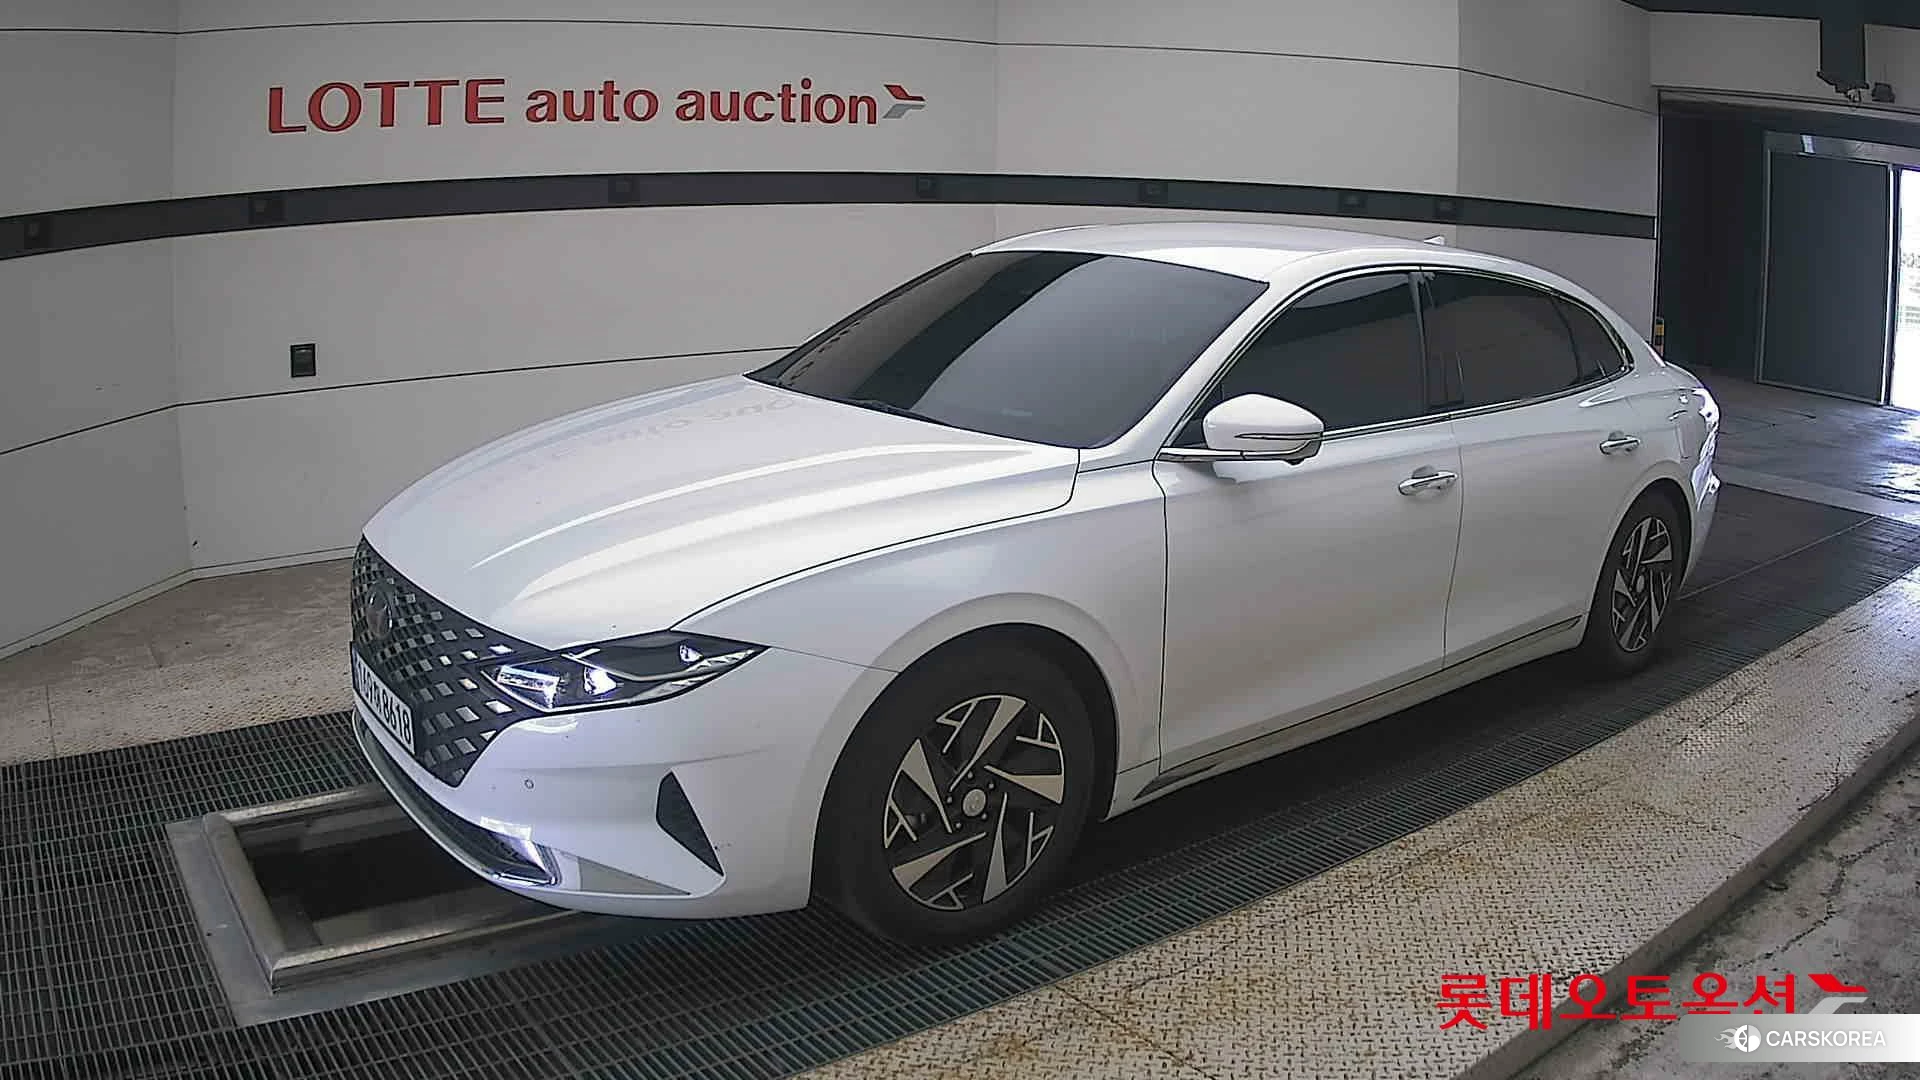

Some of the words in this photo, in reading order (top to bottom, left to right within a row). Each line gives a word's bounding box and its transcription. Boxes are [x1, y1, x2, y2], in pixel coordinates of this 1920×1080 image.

[267, 79, 505, 134] LOTTE
[525, 80, 660, 123] auto
[675, 78, 878, 125] auction
